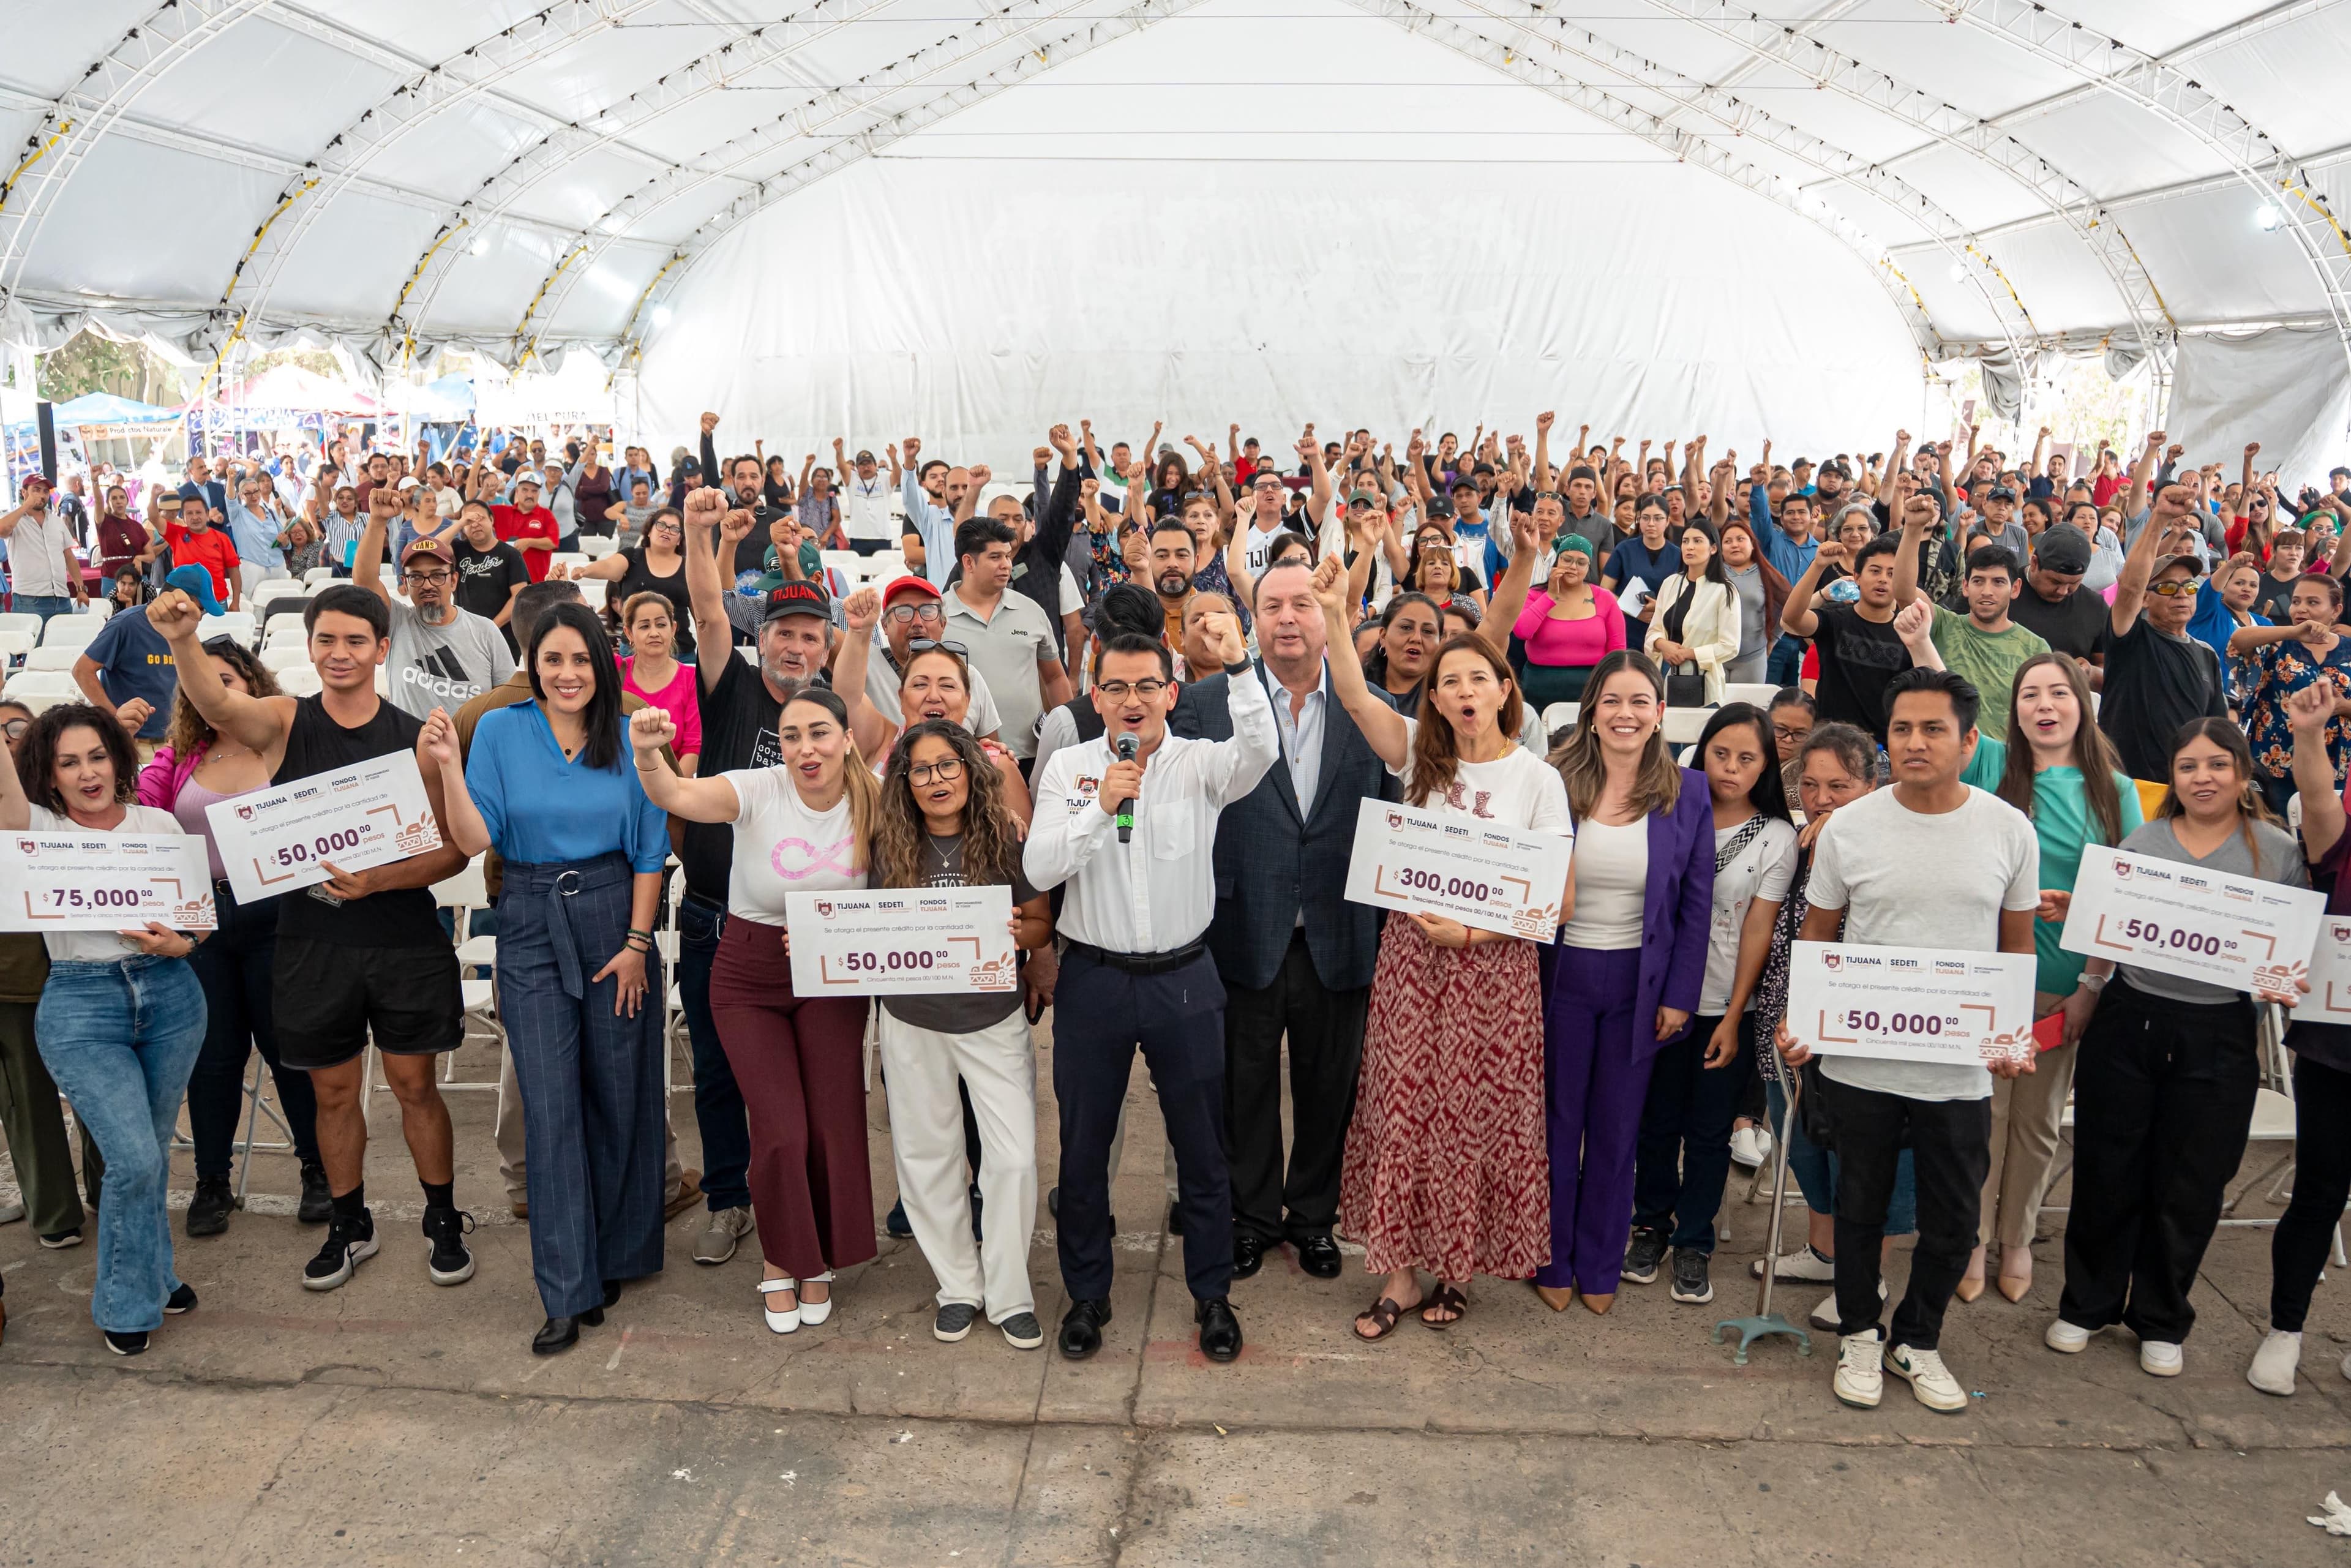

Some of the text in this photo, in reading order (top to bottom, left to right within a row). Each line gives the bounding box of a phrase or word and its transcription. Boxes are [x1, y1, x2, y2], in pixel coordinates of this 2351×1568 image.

[416, 541, 434, 550] VANS
[460, 555, 504, 583] Fender
[147, 654, 160, 664] GO
[402, 666, 481, 699] adidas
[759, 745, 784, 760] corn
[756, 752, 782, 768] bak
[332, 776, 357, 786] FONDOS
[294, 787, 318, 799] SEDETI
[255, 797, 288, 810] TIJUANA
[1407, 818, 1437, 830] TIJUANA
[362, 831, 384, 844] pesos
[1445, 826, 1468, 836] SEDETI
[1484, 833, 1509, 842] FONDOS
[270, 824, 370, 866] $ 50,000 00
[2137, 866, 2171, 879] TIJUANA
[1393, 868, 1503, 901] $ 300,000 00
[2180, 876, 2207, 887] SEDETI
[2225, 885, 2254, 896] FONDOS
[43, 893, 48, 902] $
[53, 890, 138, 910] 75,000
[1412, 895, 1444, 906] Trescientos
[1474, 909, 1494, 917] 00/100
[1489, 899, 1512, 909] pesos
[2117, 919, 2237, 956] $ 50,000 00
[838, 957, 844, 967] $
[847, 951, 933, 973] 50,000
[1846, 956, 1881, 965] TIJUANA
[1838, 1013, 1843, 1024] $
[1847, 1010, 1941, 1035] 50,000
